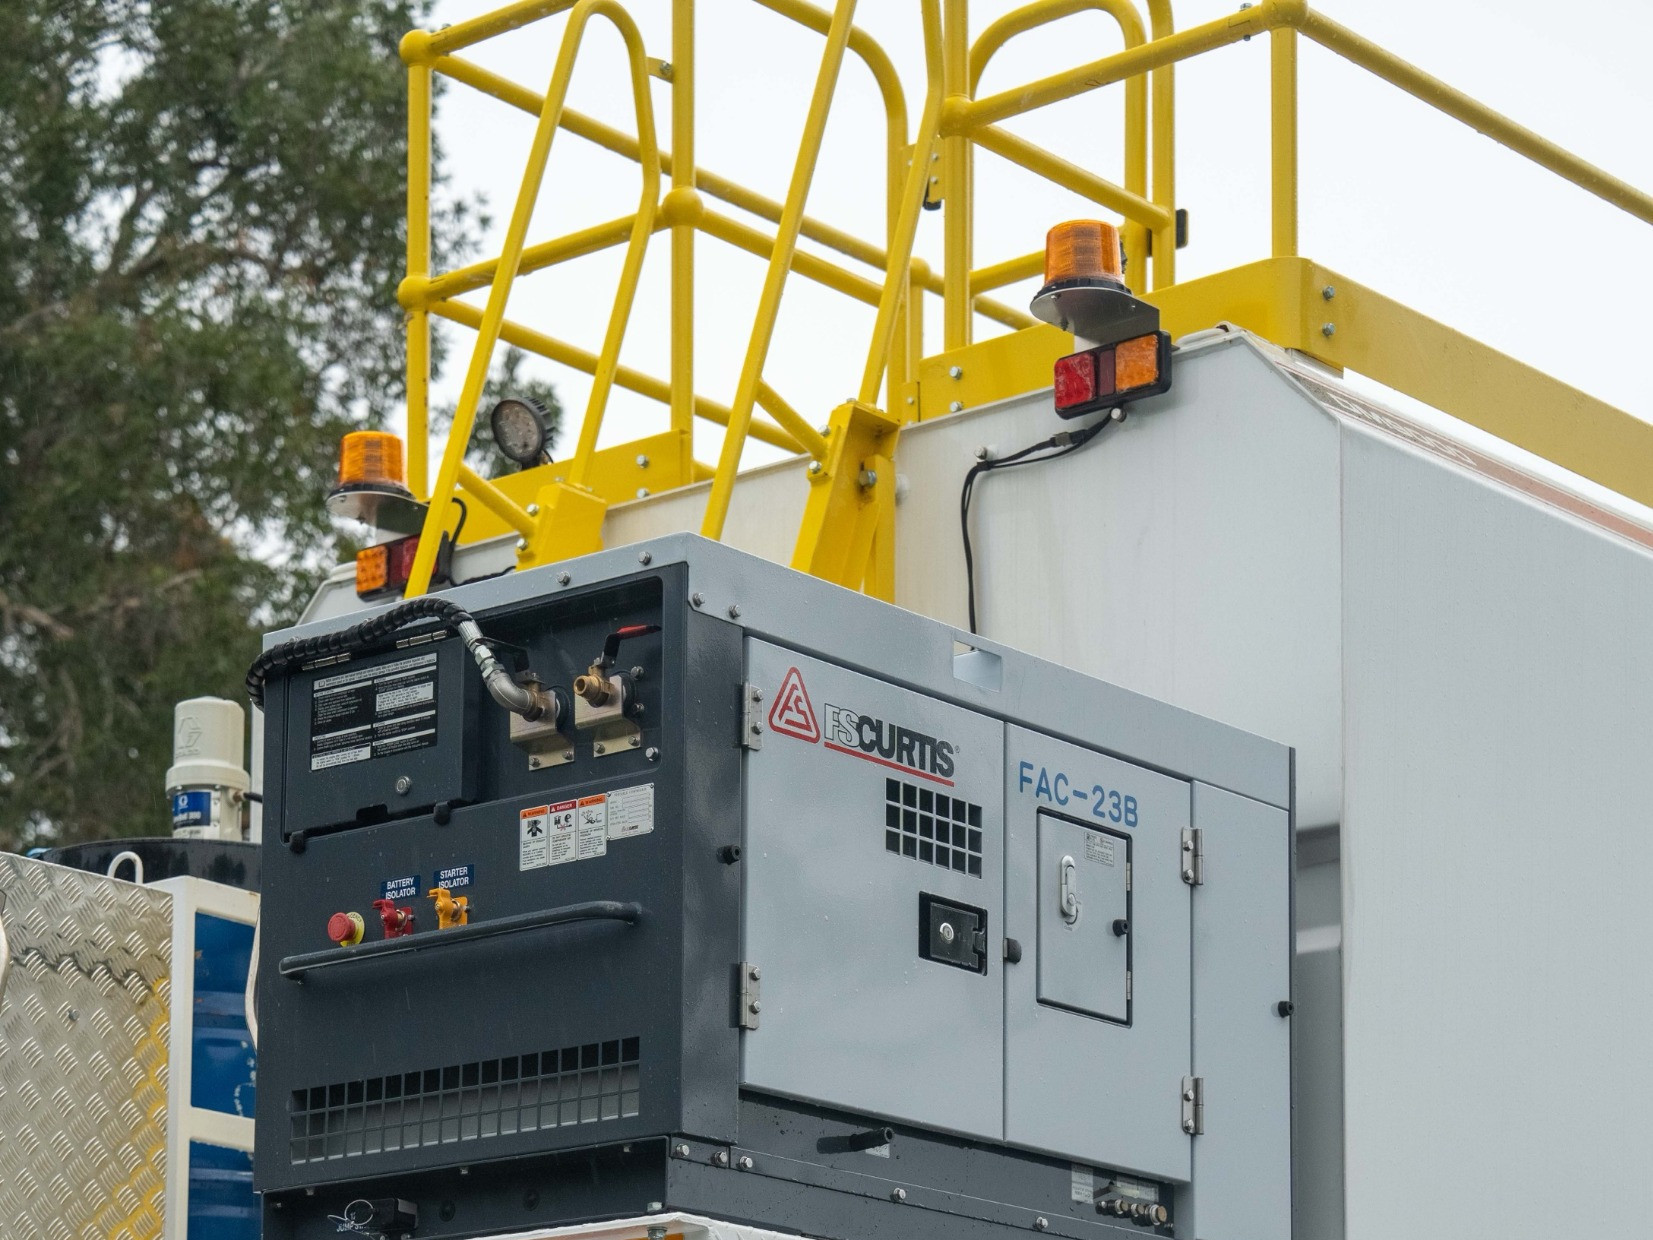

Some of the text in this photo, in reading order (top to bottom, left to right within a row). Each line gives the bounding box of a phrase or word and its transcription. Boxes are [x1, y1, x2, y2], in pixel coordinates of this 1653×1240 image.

[823, 702, 955, 778] FSCURTIS
[1019, 760, 1139, 828] FAC-23B
[439, 866, 468, 880] STARTER
[386, 876, 415, 890] BATTERY
[438, 876, 470, 890] ISOLATOR
[385, 887, 416, 900] ISOLATOR
